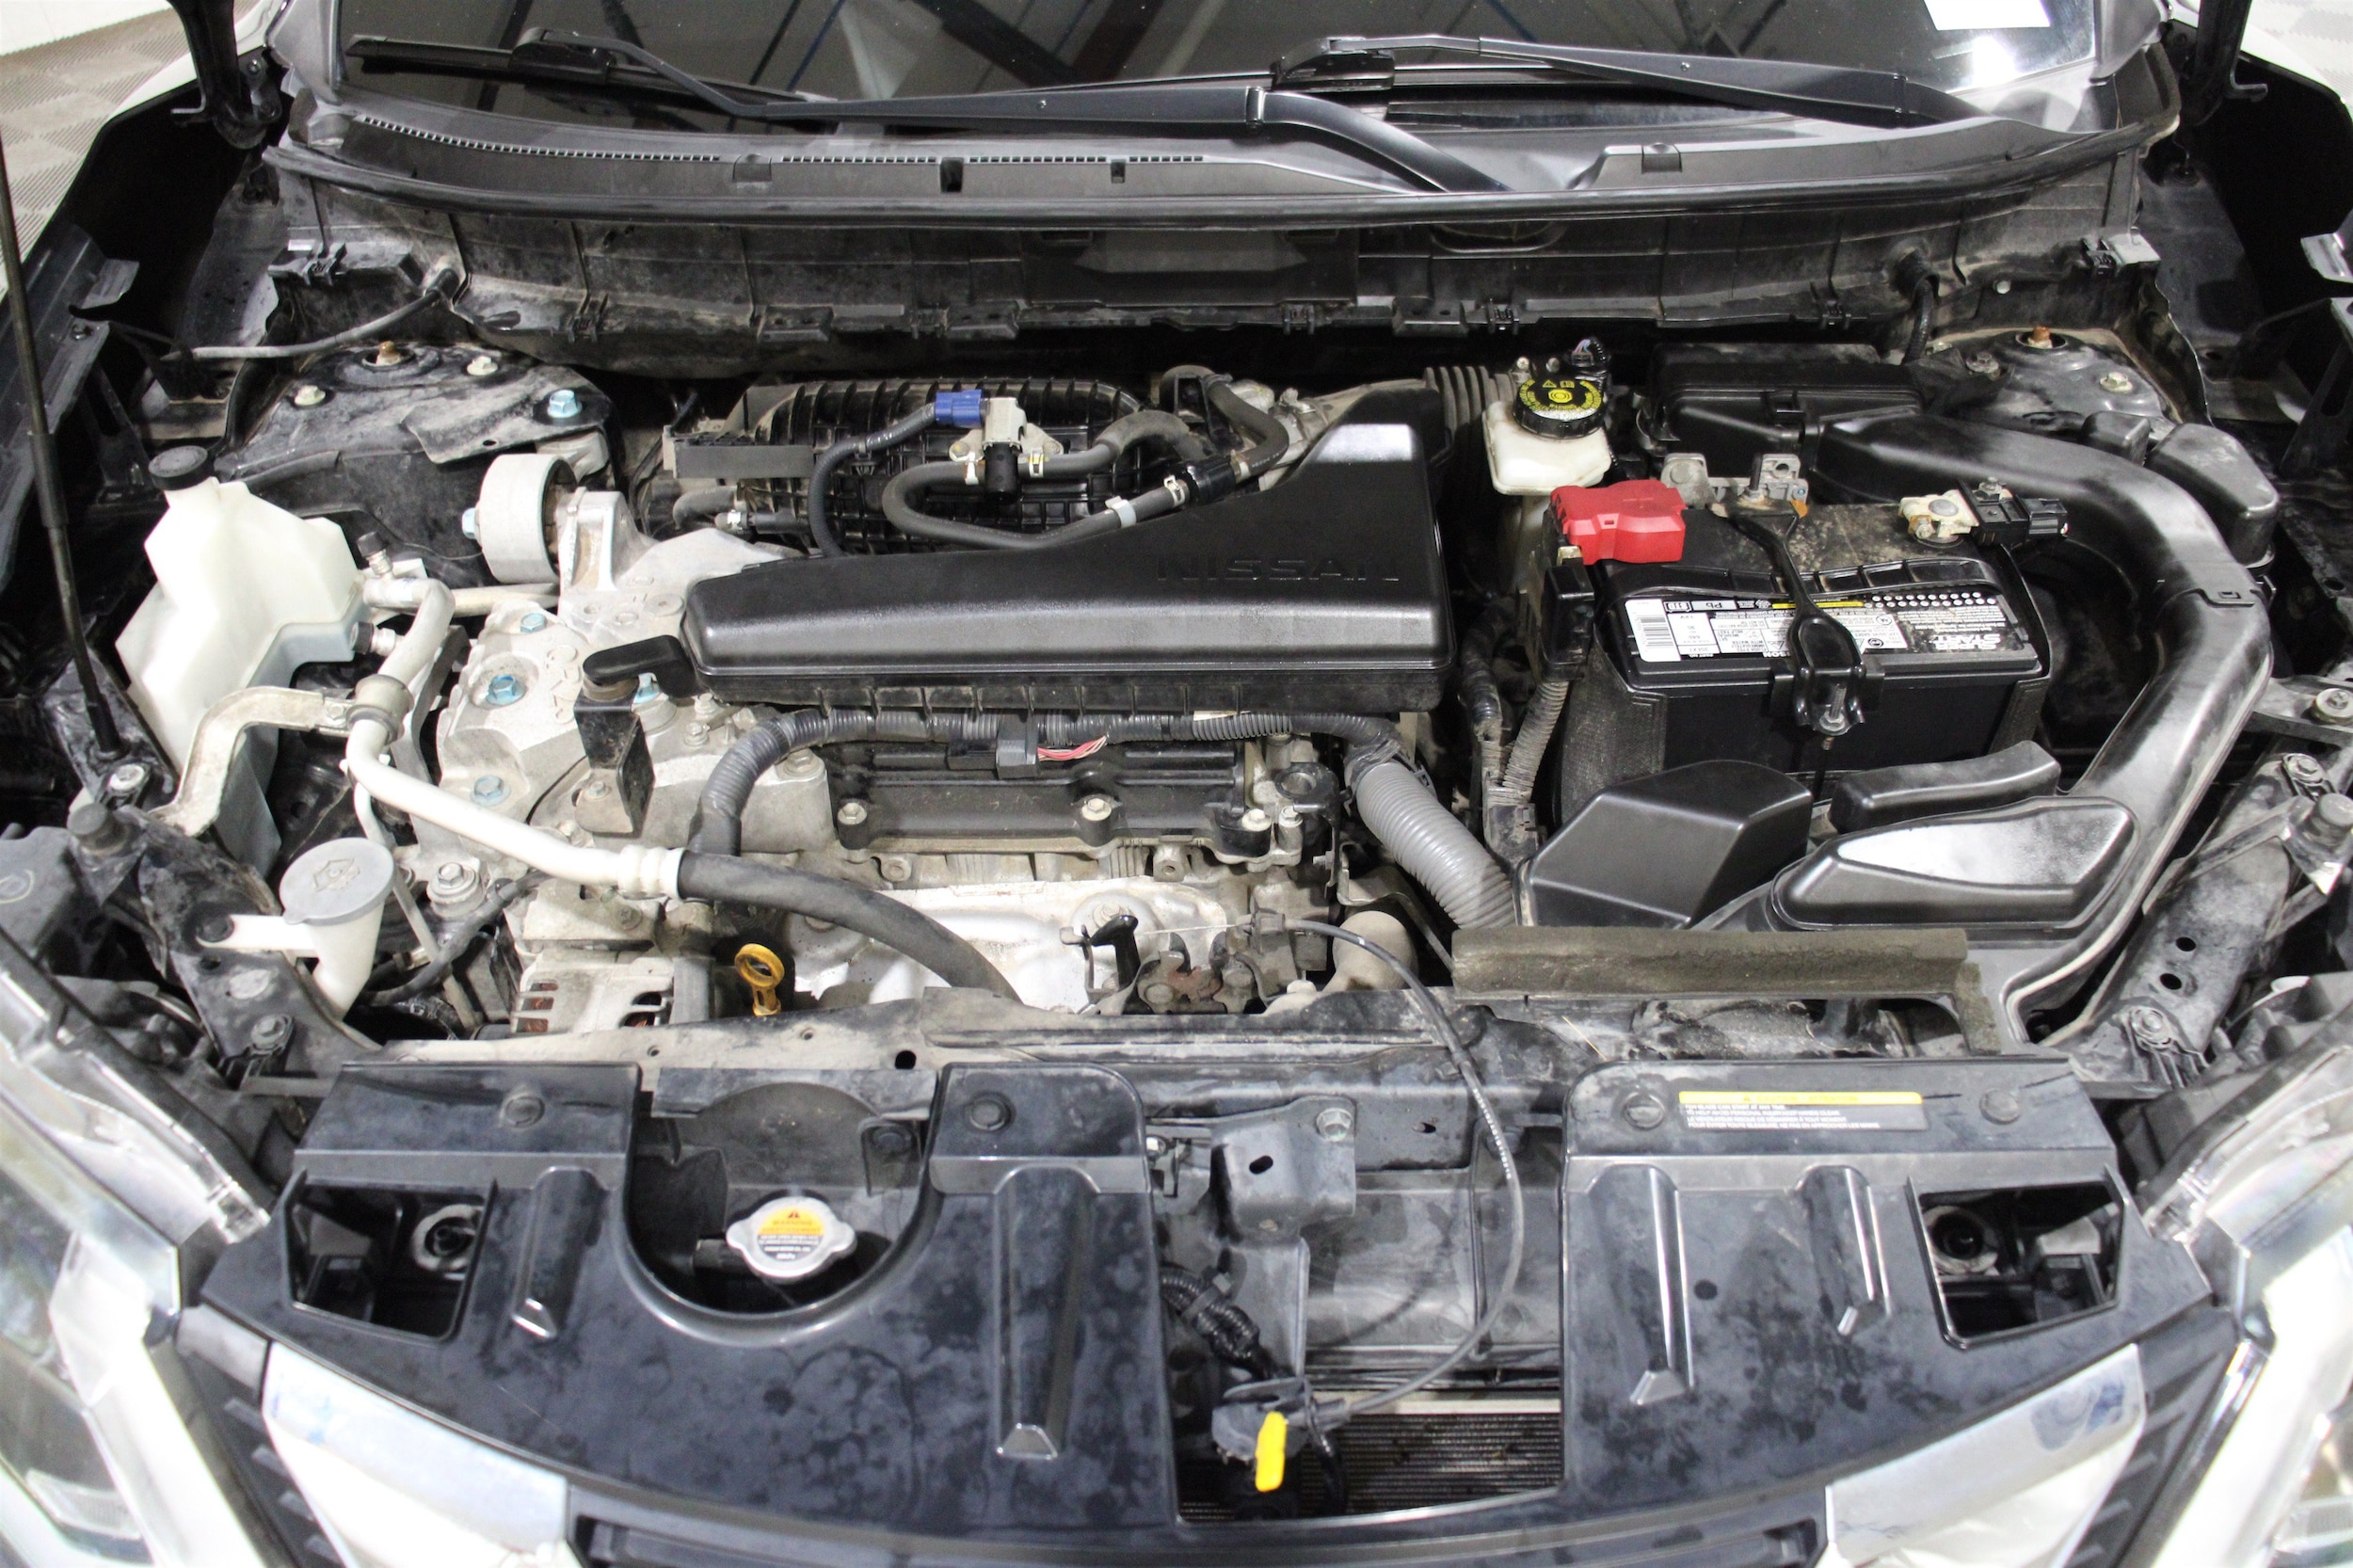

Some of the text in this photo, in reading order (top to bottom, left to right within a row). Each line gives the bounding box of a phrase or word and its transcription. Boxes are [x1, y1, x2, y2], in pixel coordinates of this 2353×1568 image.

[1156, 557, 1401, 582] NISSAN
[1932, 633, 2001, 645] START
[1934, 642, 1997, 650] SUPER
